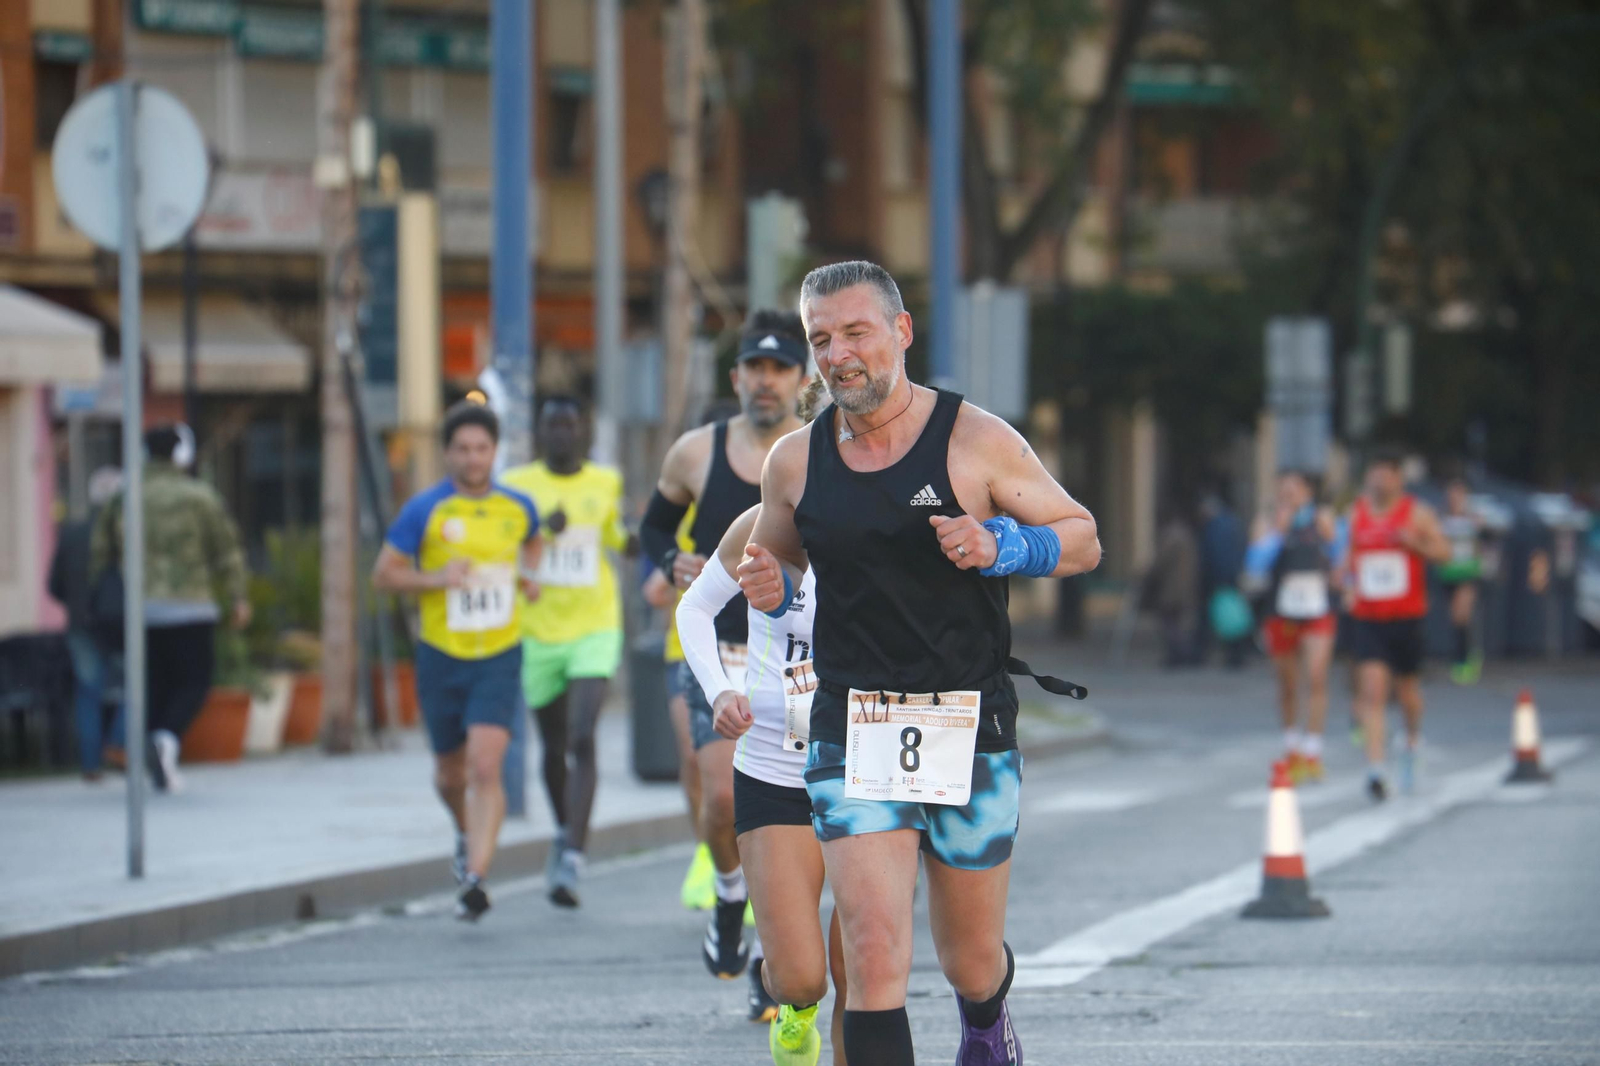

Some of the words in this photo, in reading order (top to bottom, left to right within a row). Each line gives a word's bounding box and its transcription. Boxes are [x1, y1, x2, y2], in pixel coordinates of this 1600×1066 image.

[910, 498, 942, 506] adidas
[855, 693, 891, 723] XLI
[891, 714, 922, 724] MEMORIAL
[899, 726, 922, 772] 8
